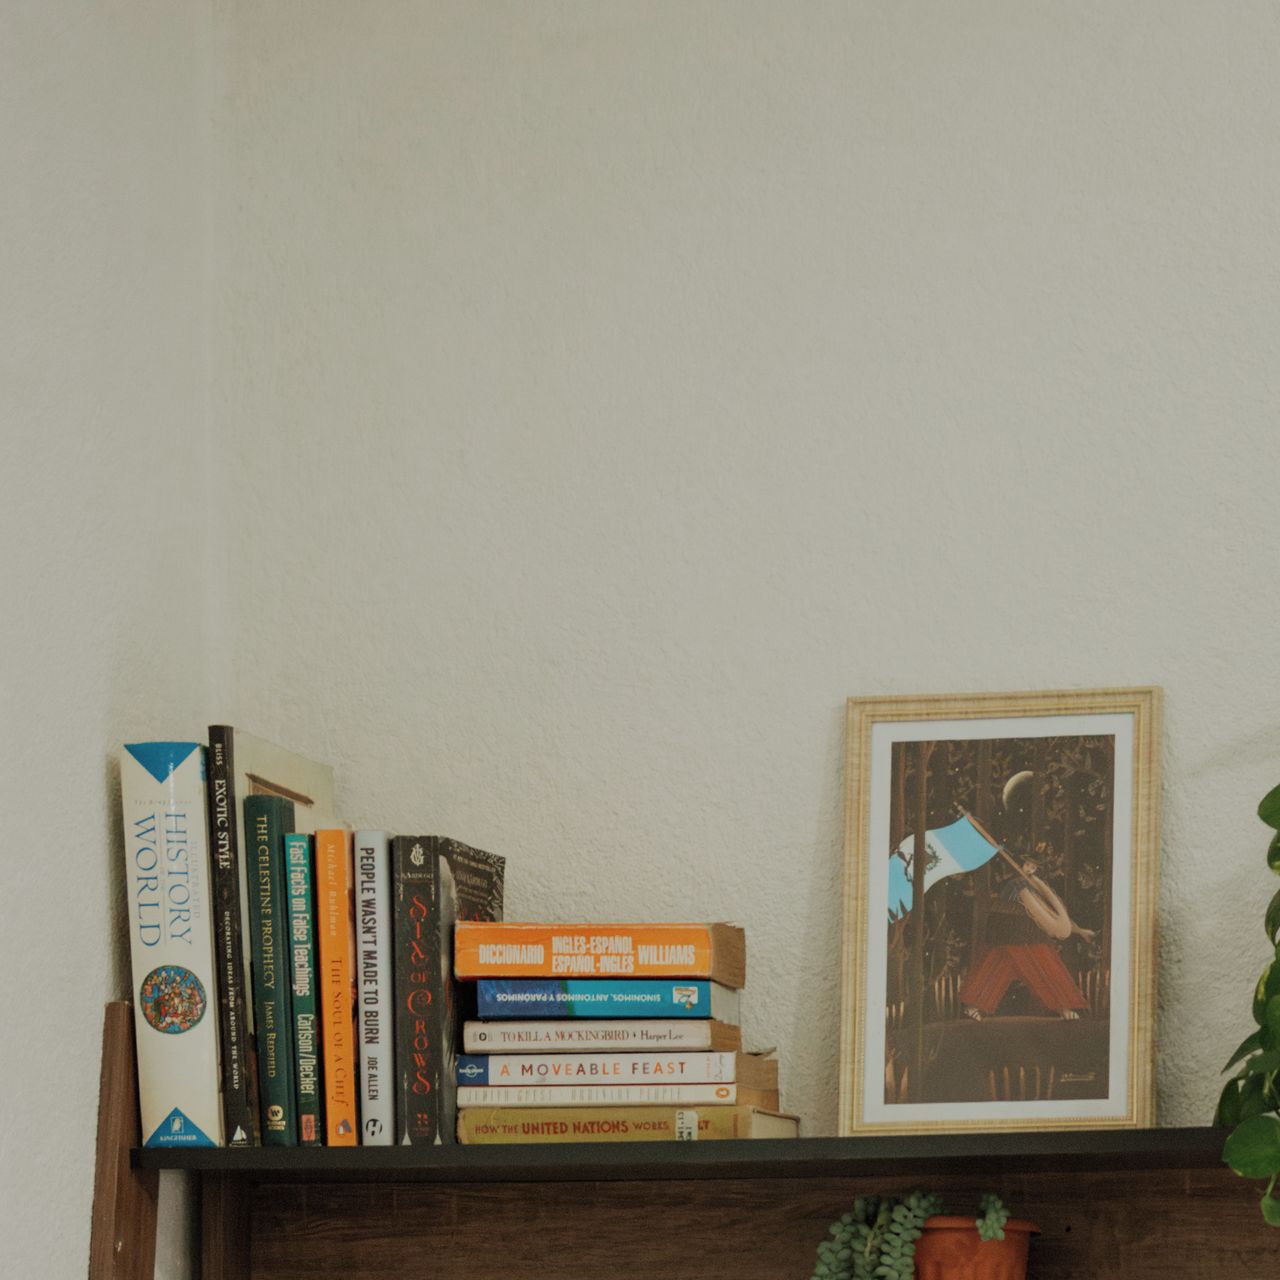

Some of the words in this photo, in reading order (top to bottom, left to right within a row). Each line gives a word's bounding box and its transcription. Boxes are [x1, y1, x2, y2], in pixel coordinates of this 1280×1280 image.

[215, 743, 223, 766] BLISS
[214, 779, 229, 832] EXOTIC
[256, 814, 268, 842] THE
[216, 832, 231, 870] STYLE
[289, 841, 307, 865] Fast
[327, 843, 339, 885] Michael
[133, 812, 162, 947] WORLD
[165, 812, 192, 945] HISTORY
[257, 845, 273, 915] CELESTINE
[291, 867, 308, 896] Facts
[360, 847, 376, 894] PEOPLE
[292, 897, 307, 911] on
[292, 913, 310, 941] False
[361, 898, 377, 946] WASN'T
[261, 919, 275, 989] PROPHECY
[363, 950, 378, 986] MADE
[479, 944, 545, 965] DICCIONARIO
[637, 944, 696, 966] WILLIAMS
[224, 911, 232, 958] DECORATING
[229, 1011, 237, 1042] AROUND
[292, 943, 312, 997] Teachings
[331, 957, 342, 985] THE
[332, 992, 343, 1027] SOUL
[364, 989, 379, 1005] TO
[549, 994, 556, 1002] Y
[264, 1001, 275, 1029] JAMES
[364, 1010, 380, 1045] BURN
[333, 1034, 344, 1049] OF
[407, 988, 432, 1095] CROWS
[500, 1031, 516, 1042] TO
[517, 1031, 543, 1041] KILL
[543, 1031, 551, 1041] A
[554, 1030, 630, 1041] MOCKINGBIRD
[640, 1031, 667, 1043] Harper
[668, 1031, 684, 1041] Lee
[266, 1032, 277, 1078] REDFIELD
[297, 1013, 317, 1095] Carlson/Decker
[334, 1054, 344, 1064] A
[367, 1056, 378, 1072] JOE
[500, 1064, 510, 1077] A
[520, 1062, 621, 1077] MOVEABLE
[631, 1061, 687, 1075] FEAST
[367, 1073, 379, 1101] ALLEN
[474, 1123, 498, 1134] HOW
[502, 1124, 519, 1134] THE
[521, 1121, 568, 1135] UNITED
[572, 1120, 629, 1135] NATIONS
[632, 1121, 669, 1130] WORKS
